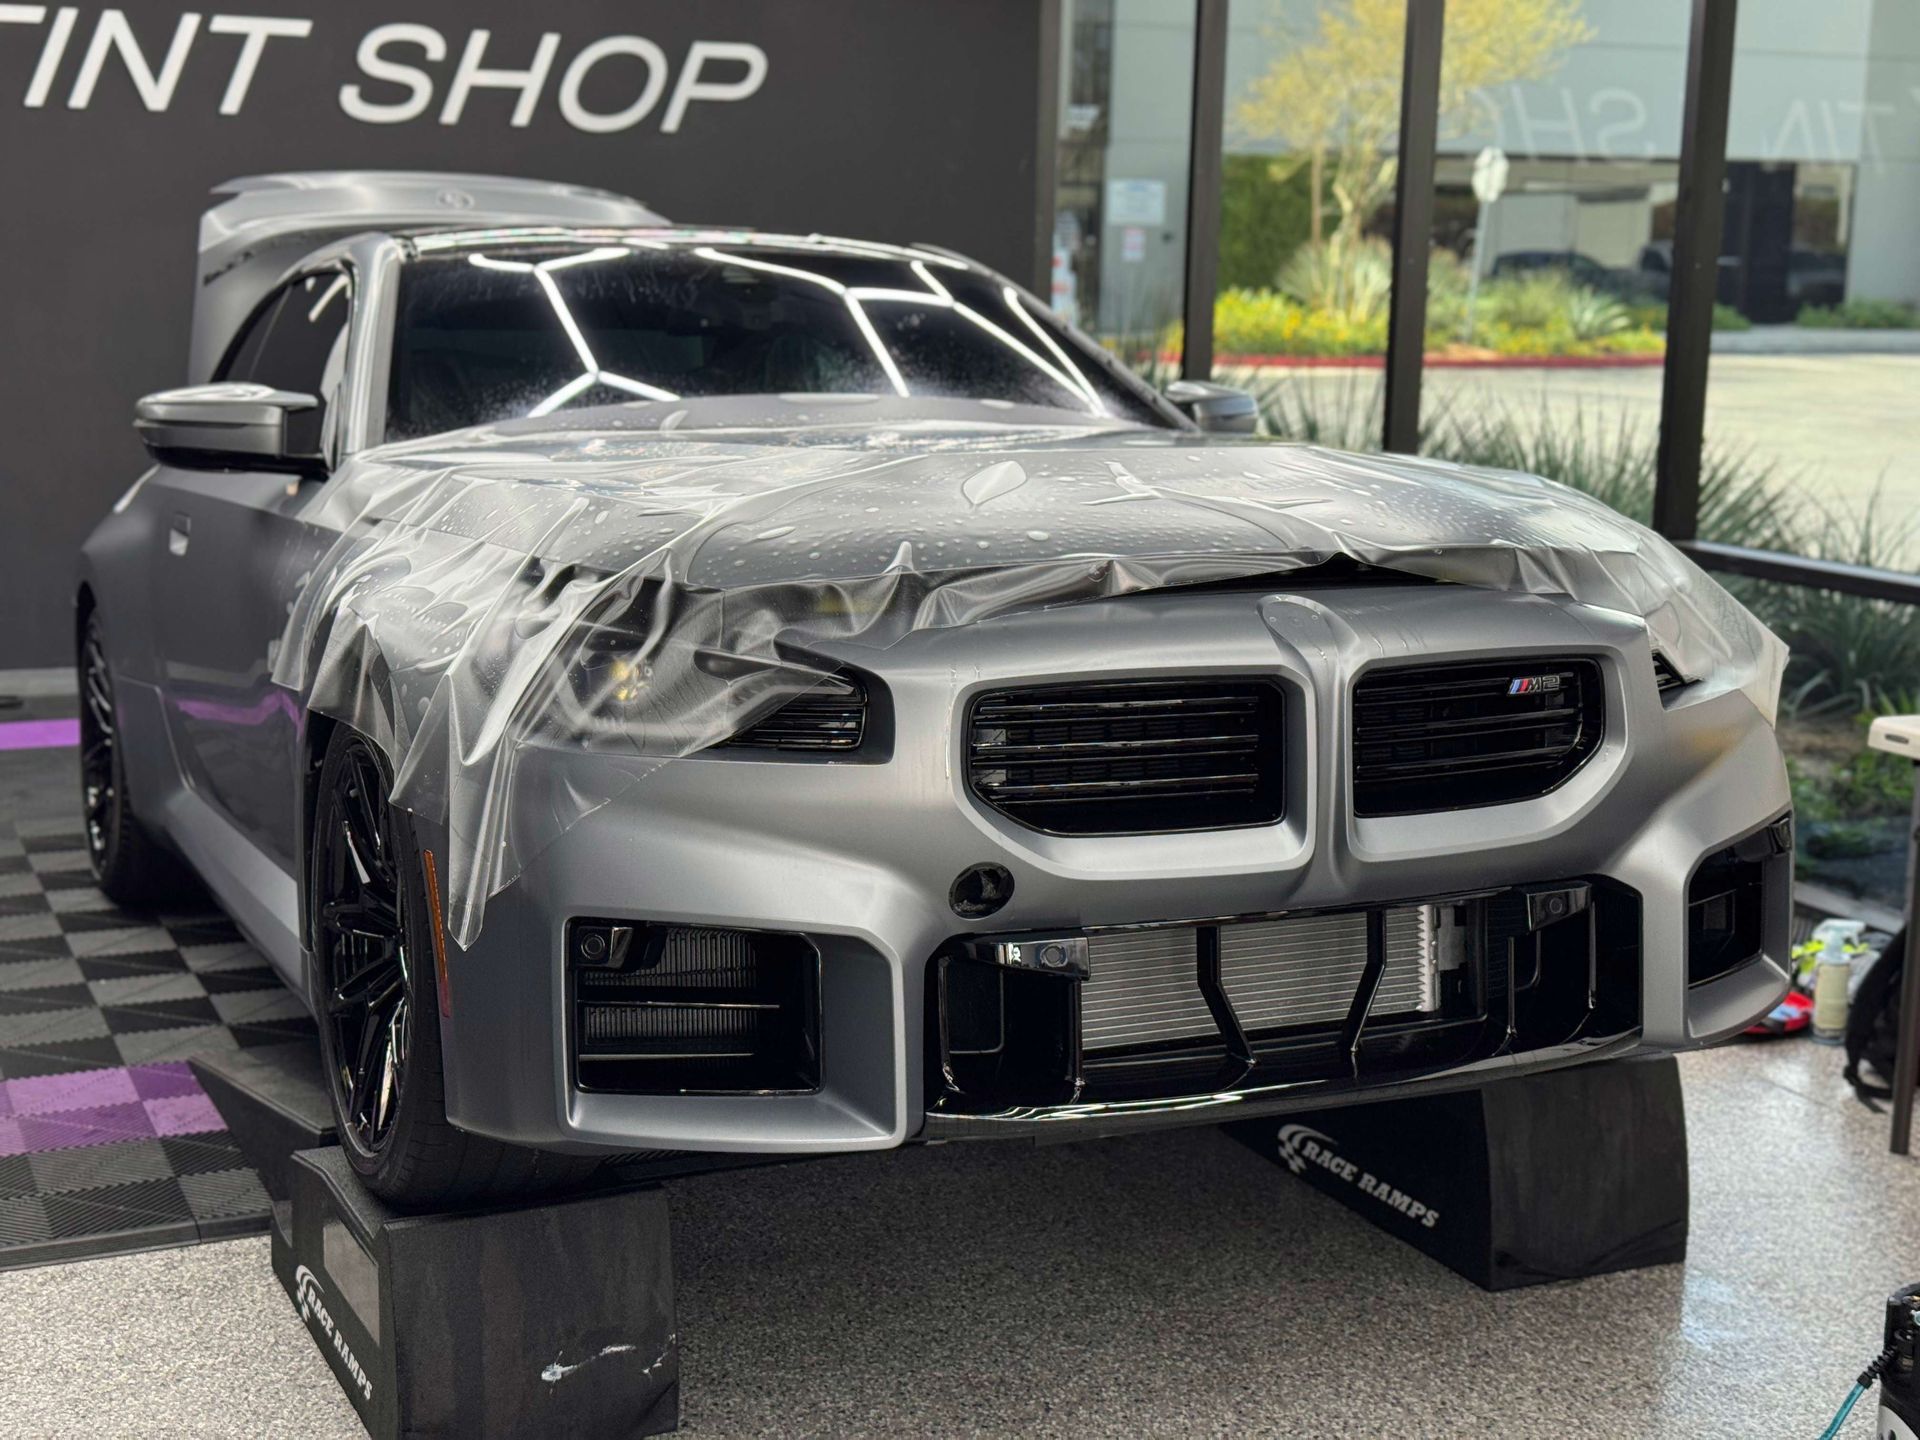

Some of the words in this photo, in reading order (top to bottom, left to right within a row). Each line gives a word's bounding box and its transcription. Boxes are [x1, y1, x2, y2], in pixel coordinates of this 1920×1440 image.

[0, 4, 313, 116] INT
[339, 23, 769, 134] SHOP
[1525, 675, 1560, 693] M2
[1302, 1140, 1358, 1181] RACE
[1358, 1172, 1440, 1228] RAMPS
[307, 1285, 335, 1337] RACE
[333, 1329, 373, 1401] RAMPS
